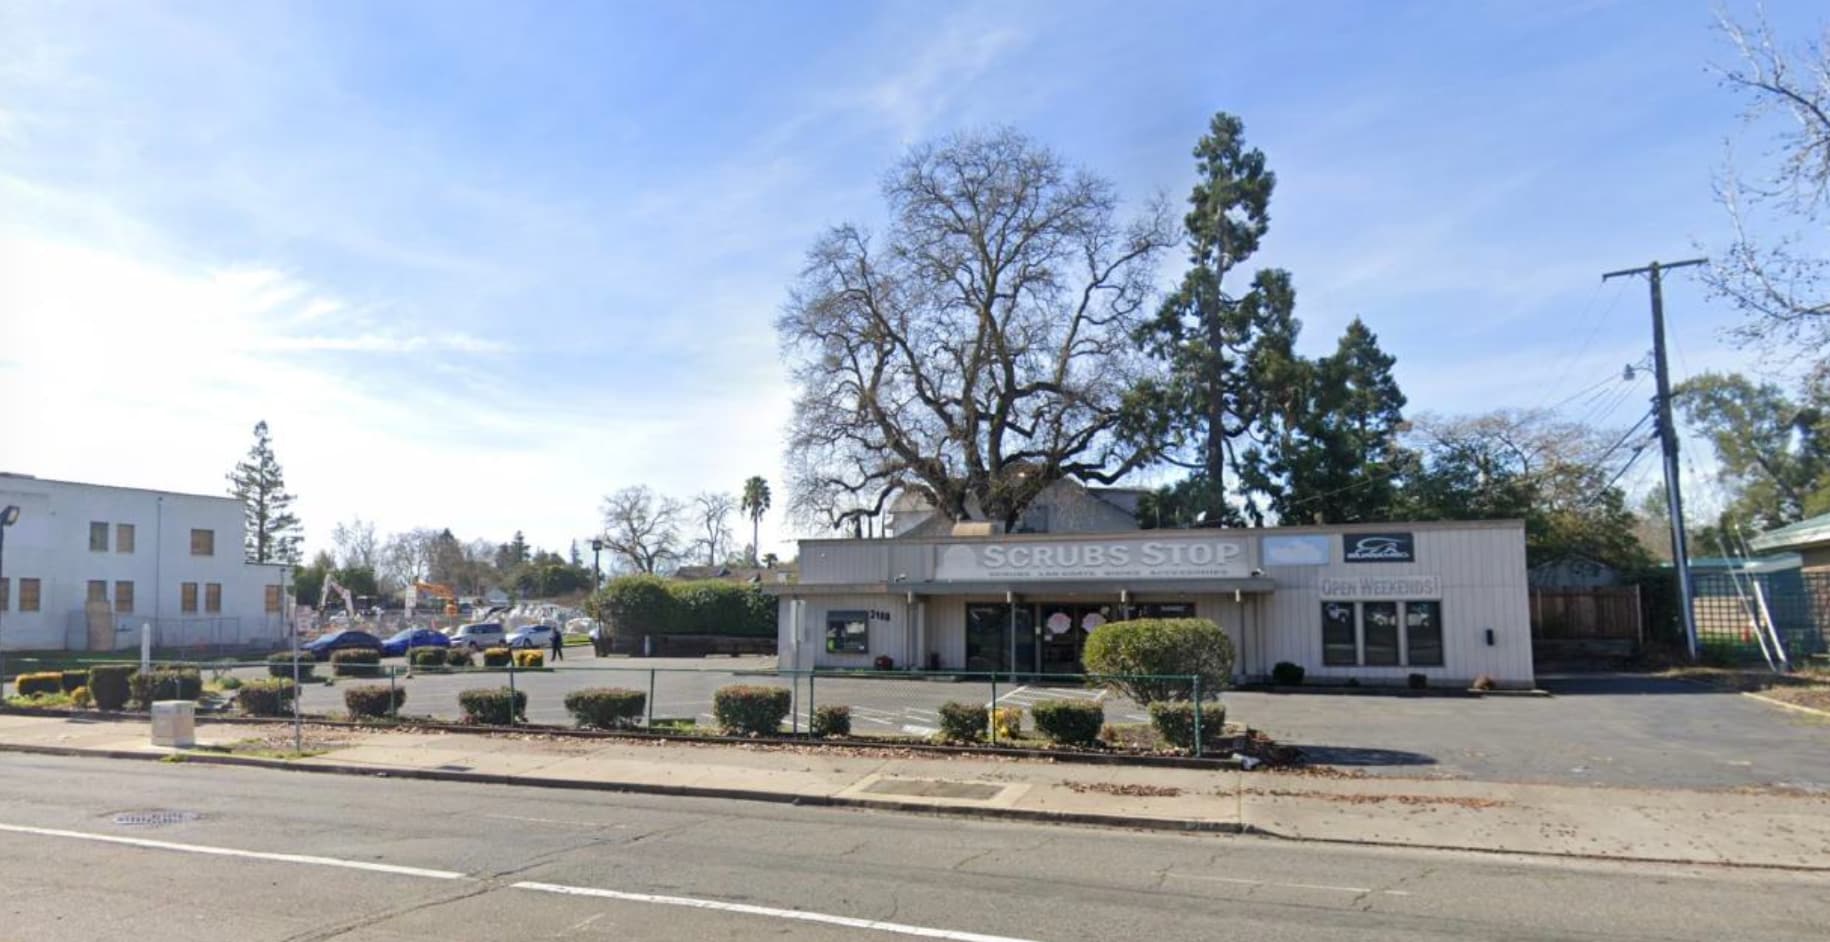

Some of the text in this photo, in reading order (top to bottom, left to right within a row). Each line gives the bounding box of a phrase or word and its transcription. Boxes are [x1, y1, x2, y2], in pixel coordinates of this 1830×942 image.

[983, 542, 1240, 568] SCRUBS STOP
[1322, 579, 1357, 596] OPEN
